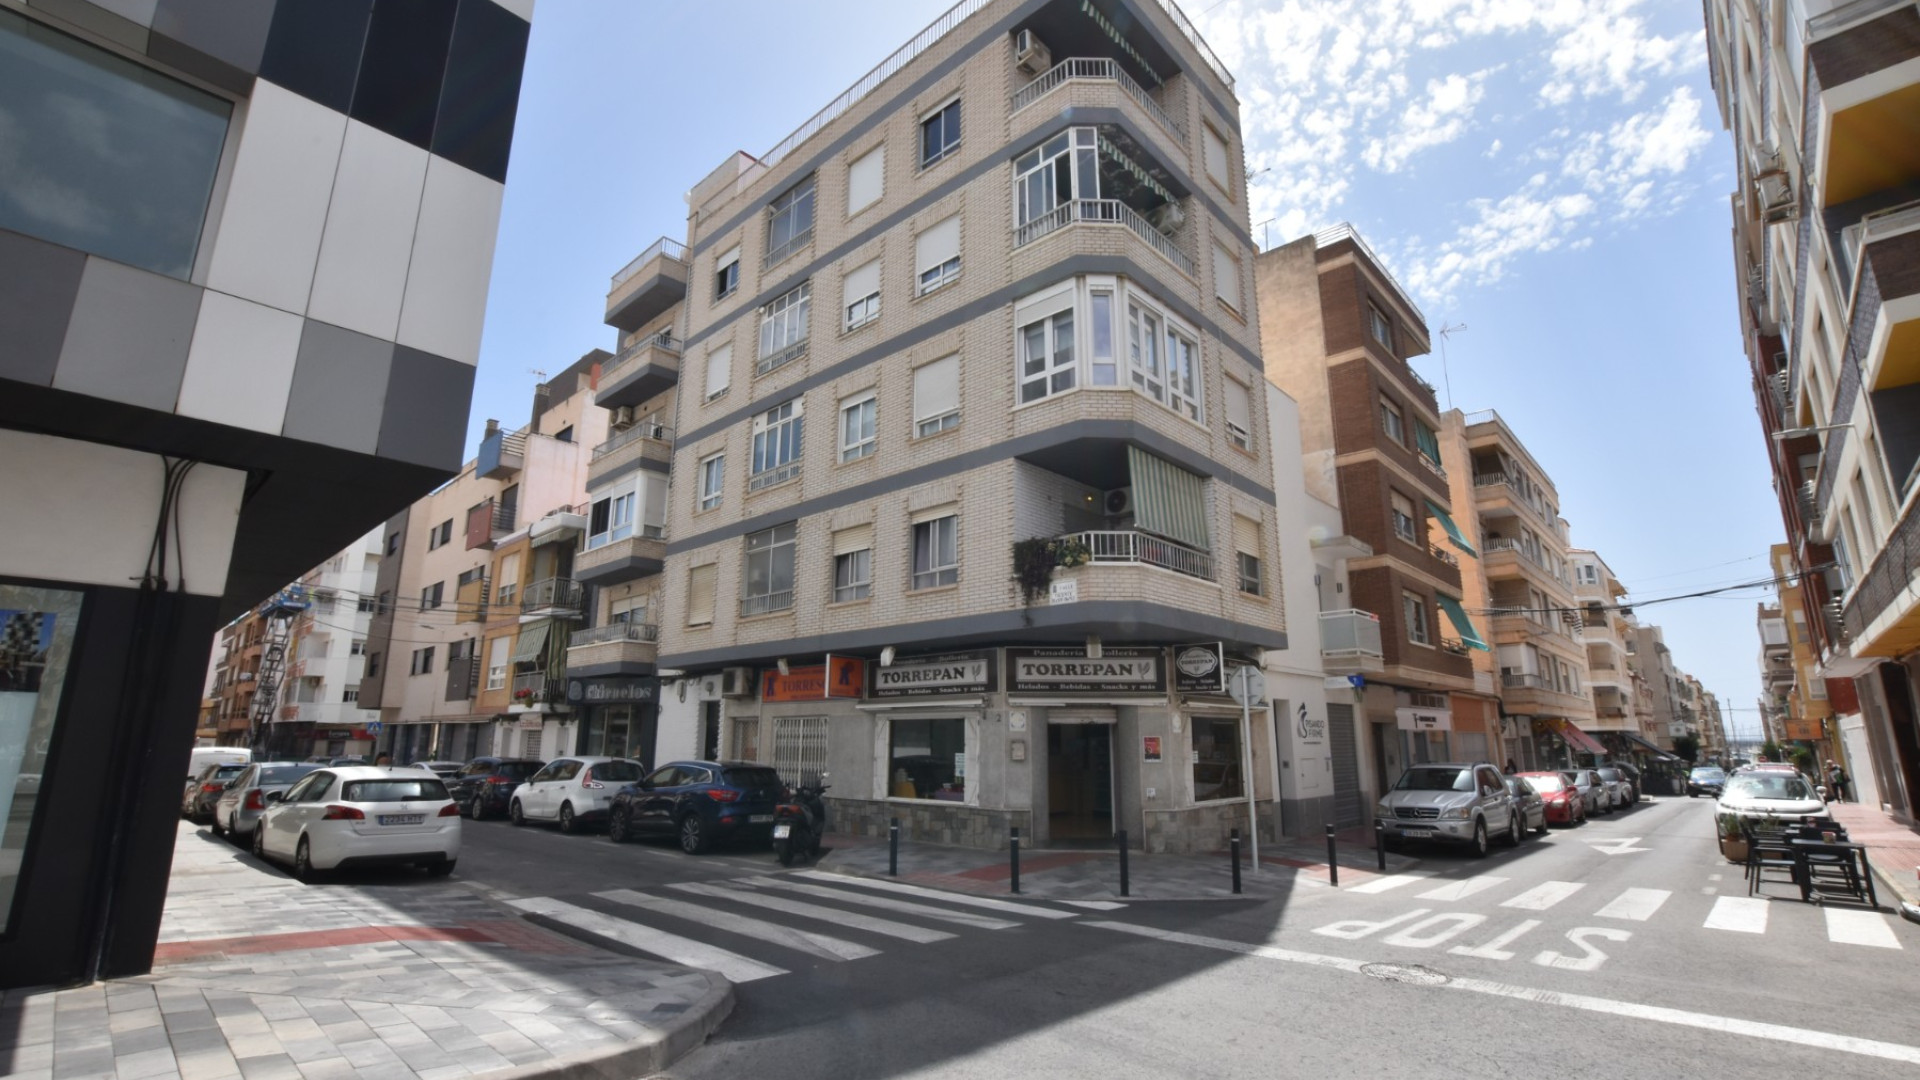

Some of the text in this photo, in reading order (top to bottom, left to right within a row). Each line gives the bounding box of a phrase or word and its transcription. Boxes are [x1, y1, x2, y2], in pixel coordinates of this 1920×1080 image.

[881, 666, 965, 684] TORREPAN
[1023, 663, 1133, 676] TORREPAN
[783, 678, 826, 692] TORRES
[879, 689, 901, 697] Helados
[1305, 719, 1324, 729] PISANDO
[1310, 908, 1633, 971] STOP
